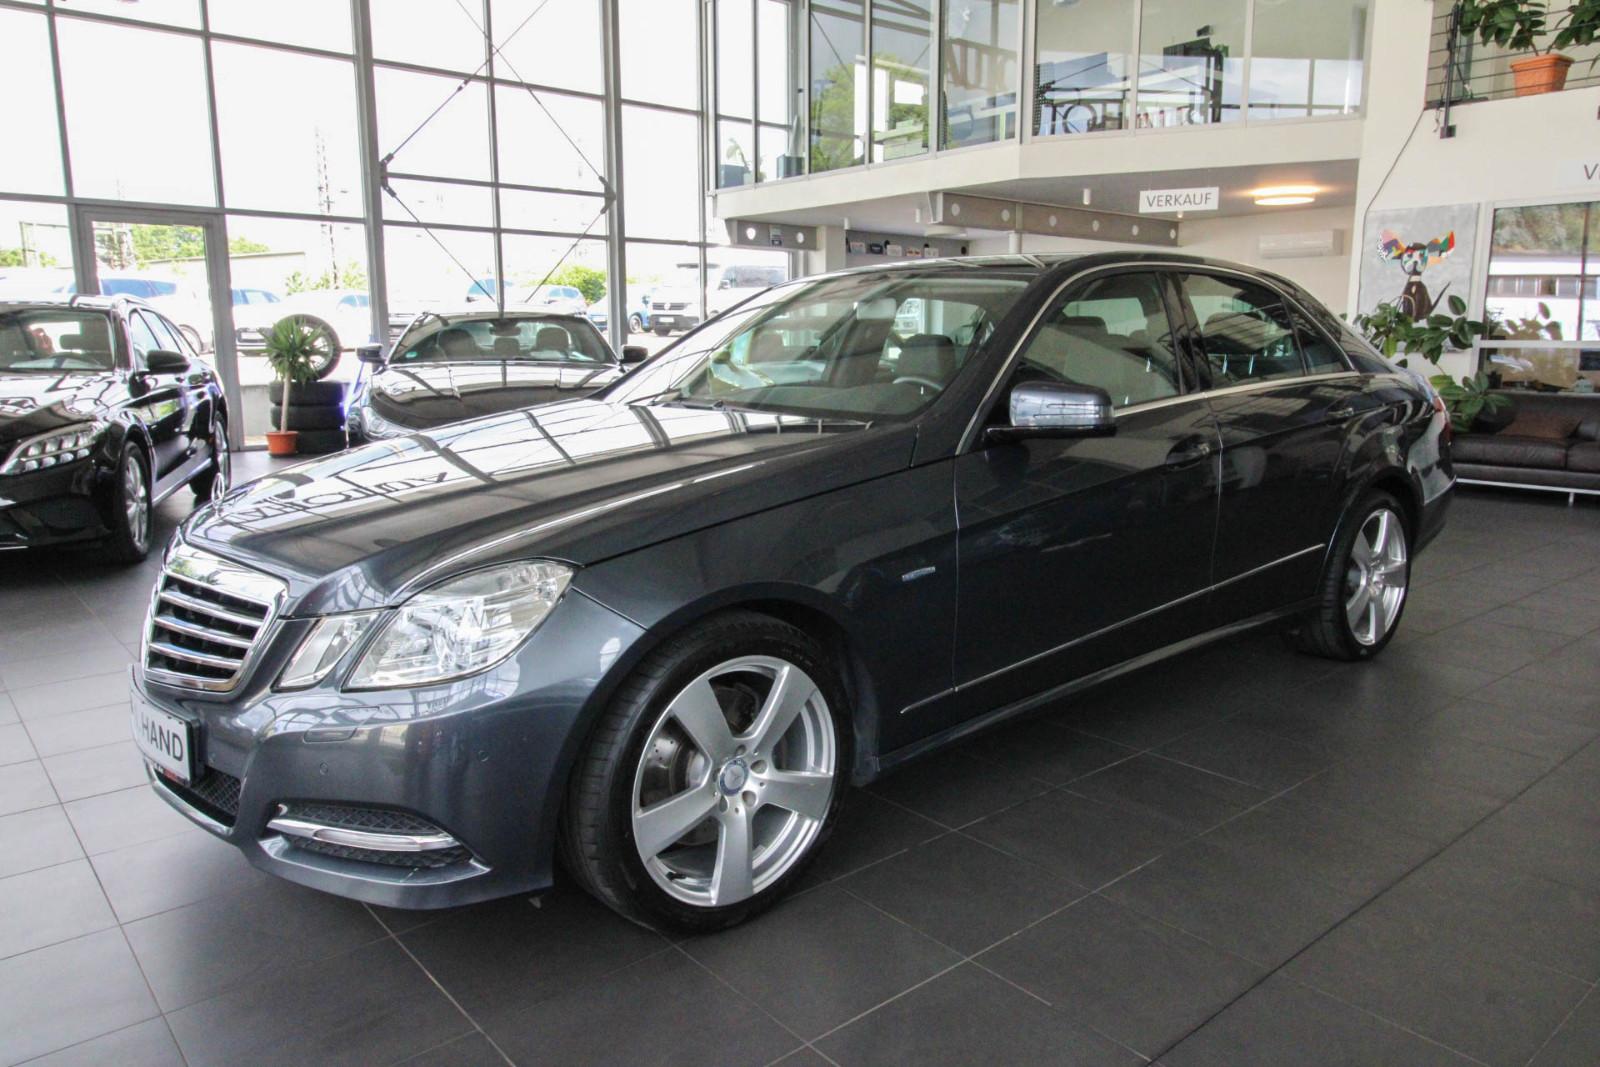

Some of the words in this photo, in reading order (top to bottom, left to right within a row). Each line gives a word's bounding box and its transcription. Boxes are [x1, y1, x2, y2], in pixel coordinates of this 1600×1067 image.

[1583, 163, 1600, 180] V
[1146, 192, 1213, 208] VERKAUF
[141, 711, 184, 762] HAND
